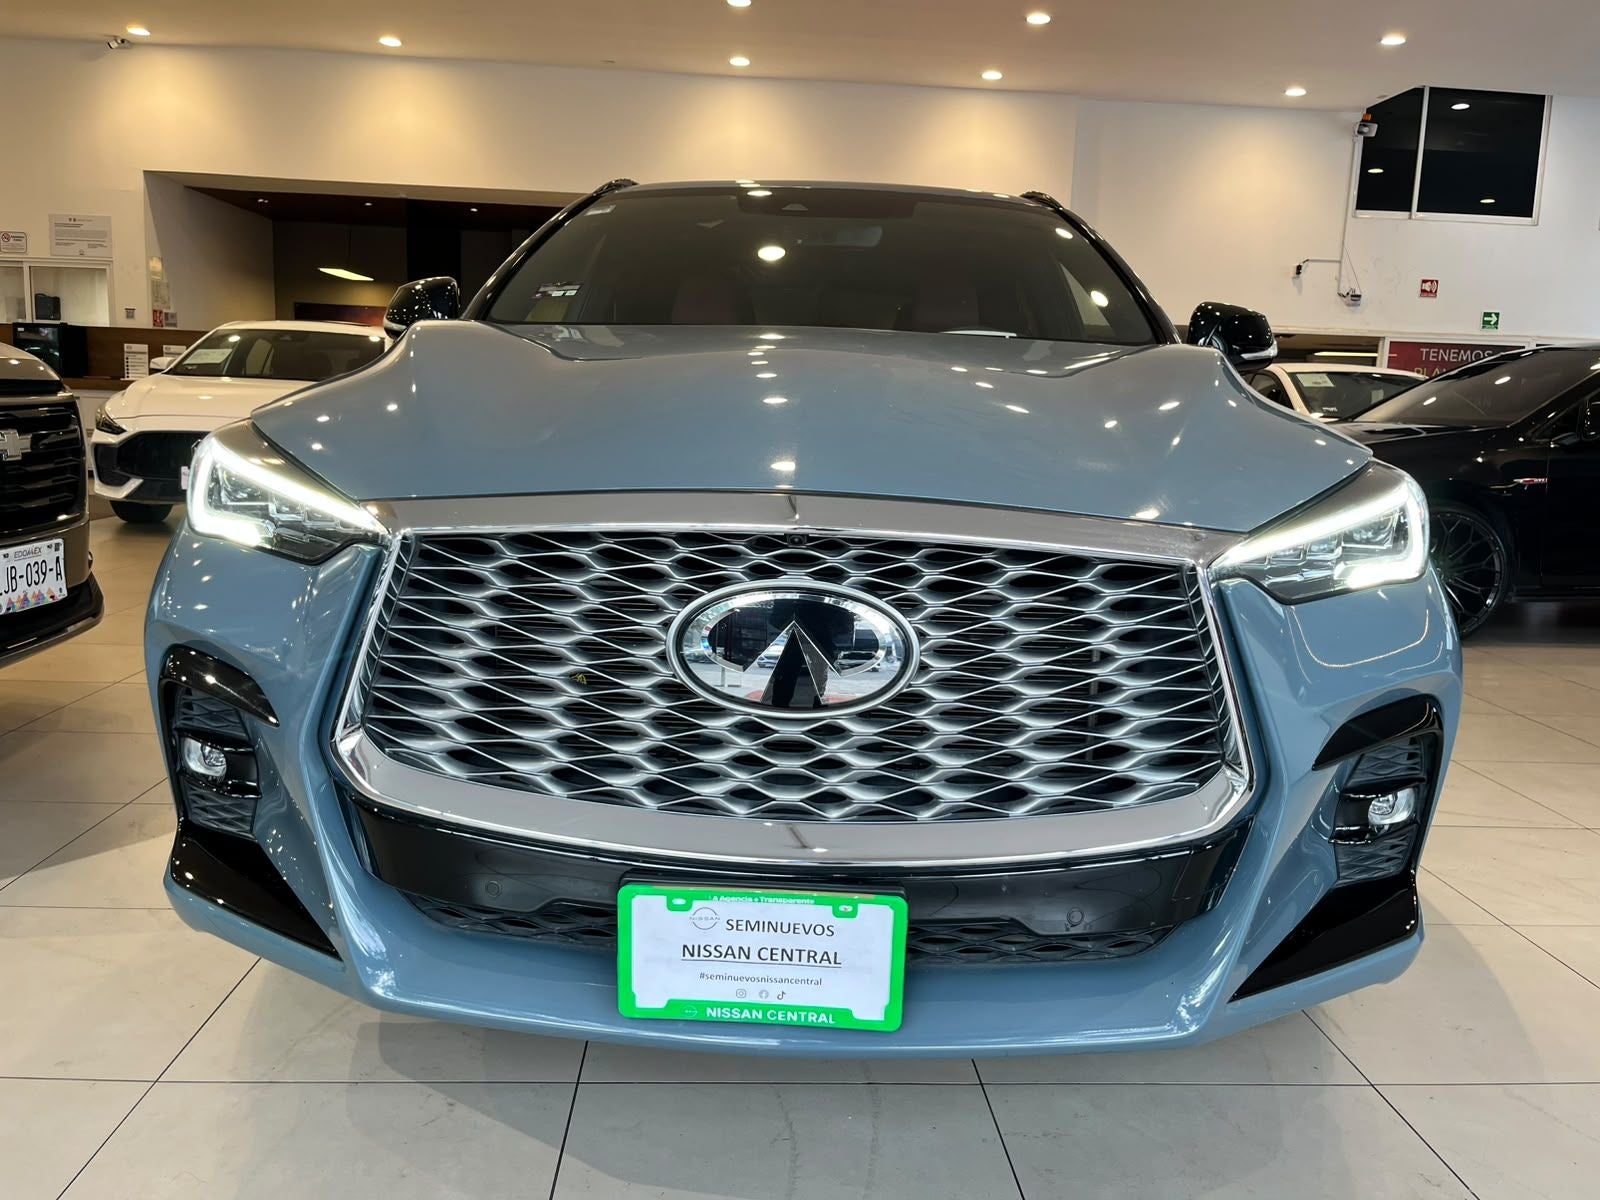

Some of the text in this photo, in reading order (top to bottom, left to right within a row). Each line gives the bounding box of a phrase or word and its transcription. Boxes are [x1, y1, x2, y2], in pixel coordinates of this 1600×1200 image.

[14, 547, 42, 559] EDOMEX
[0, 556, 63, 596] JB-039-A
[725, 918, 835, 937] SEMINUEVOS
[682, 944, 842, 965] NISSAN CENTRAL
[699, 972, 822, 986] #seminuevosnissancentral
[706, 1007, 836, 1024] NISSAN CENTRAL
